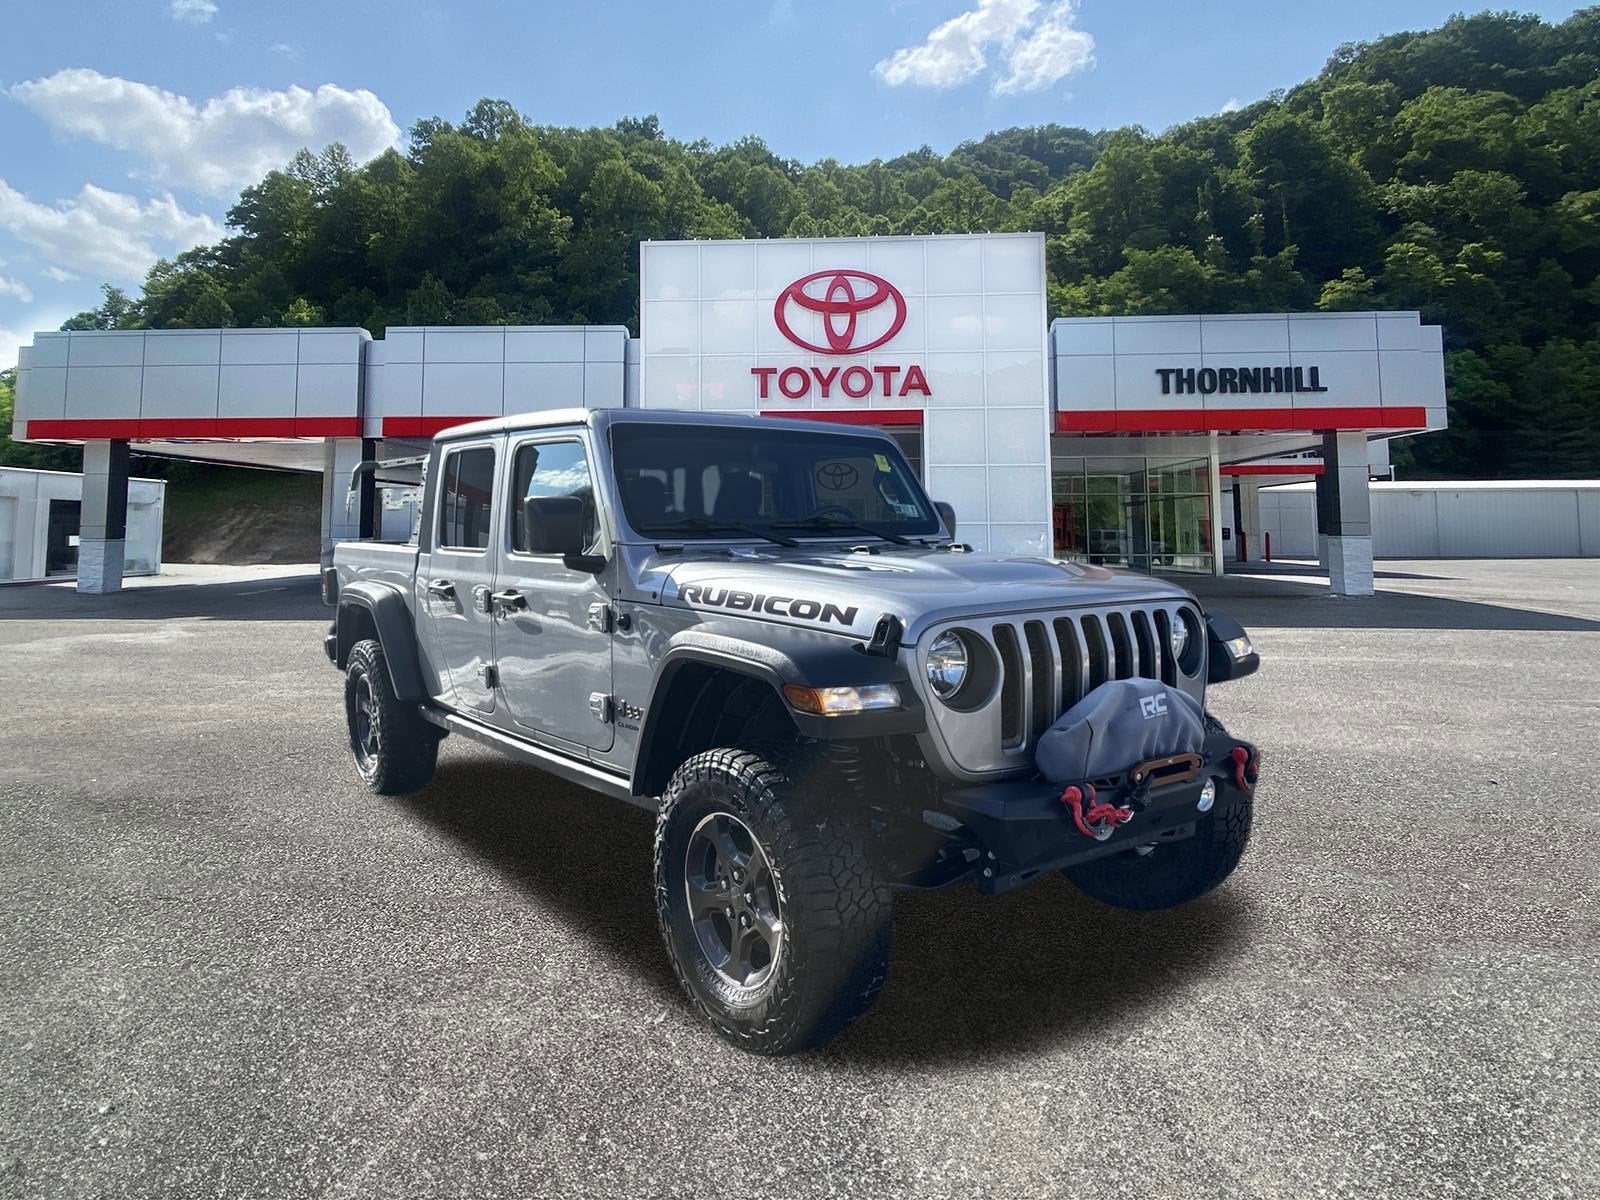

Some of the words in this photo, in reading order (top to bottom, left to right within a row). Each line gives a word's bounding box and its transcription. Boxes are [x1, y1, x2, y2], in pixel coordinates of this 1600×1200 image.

[751, 365, 932, 399] TOYOTA
[1155, 366, 1328, 394] THORNHILL
[677, 583, 859, 626] RUBICON
[1139, 692, 1167, 716] RC
